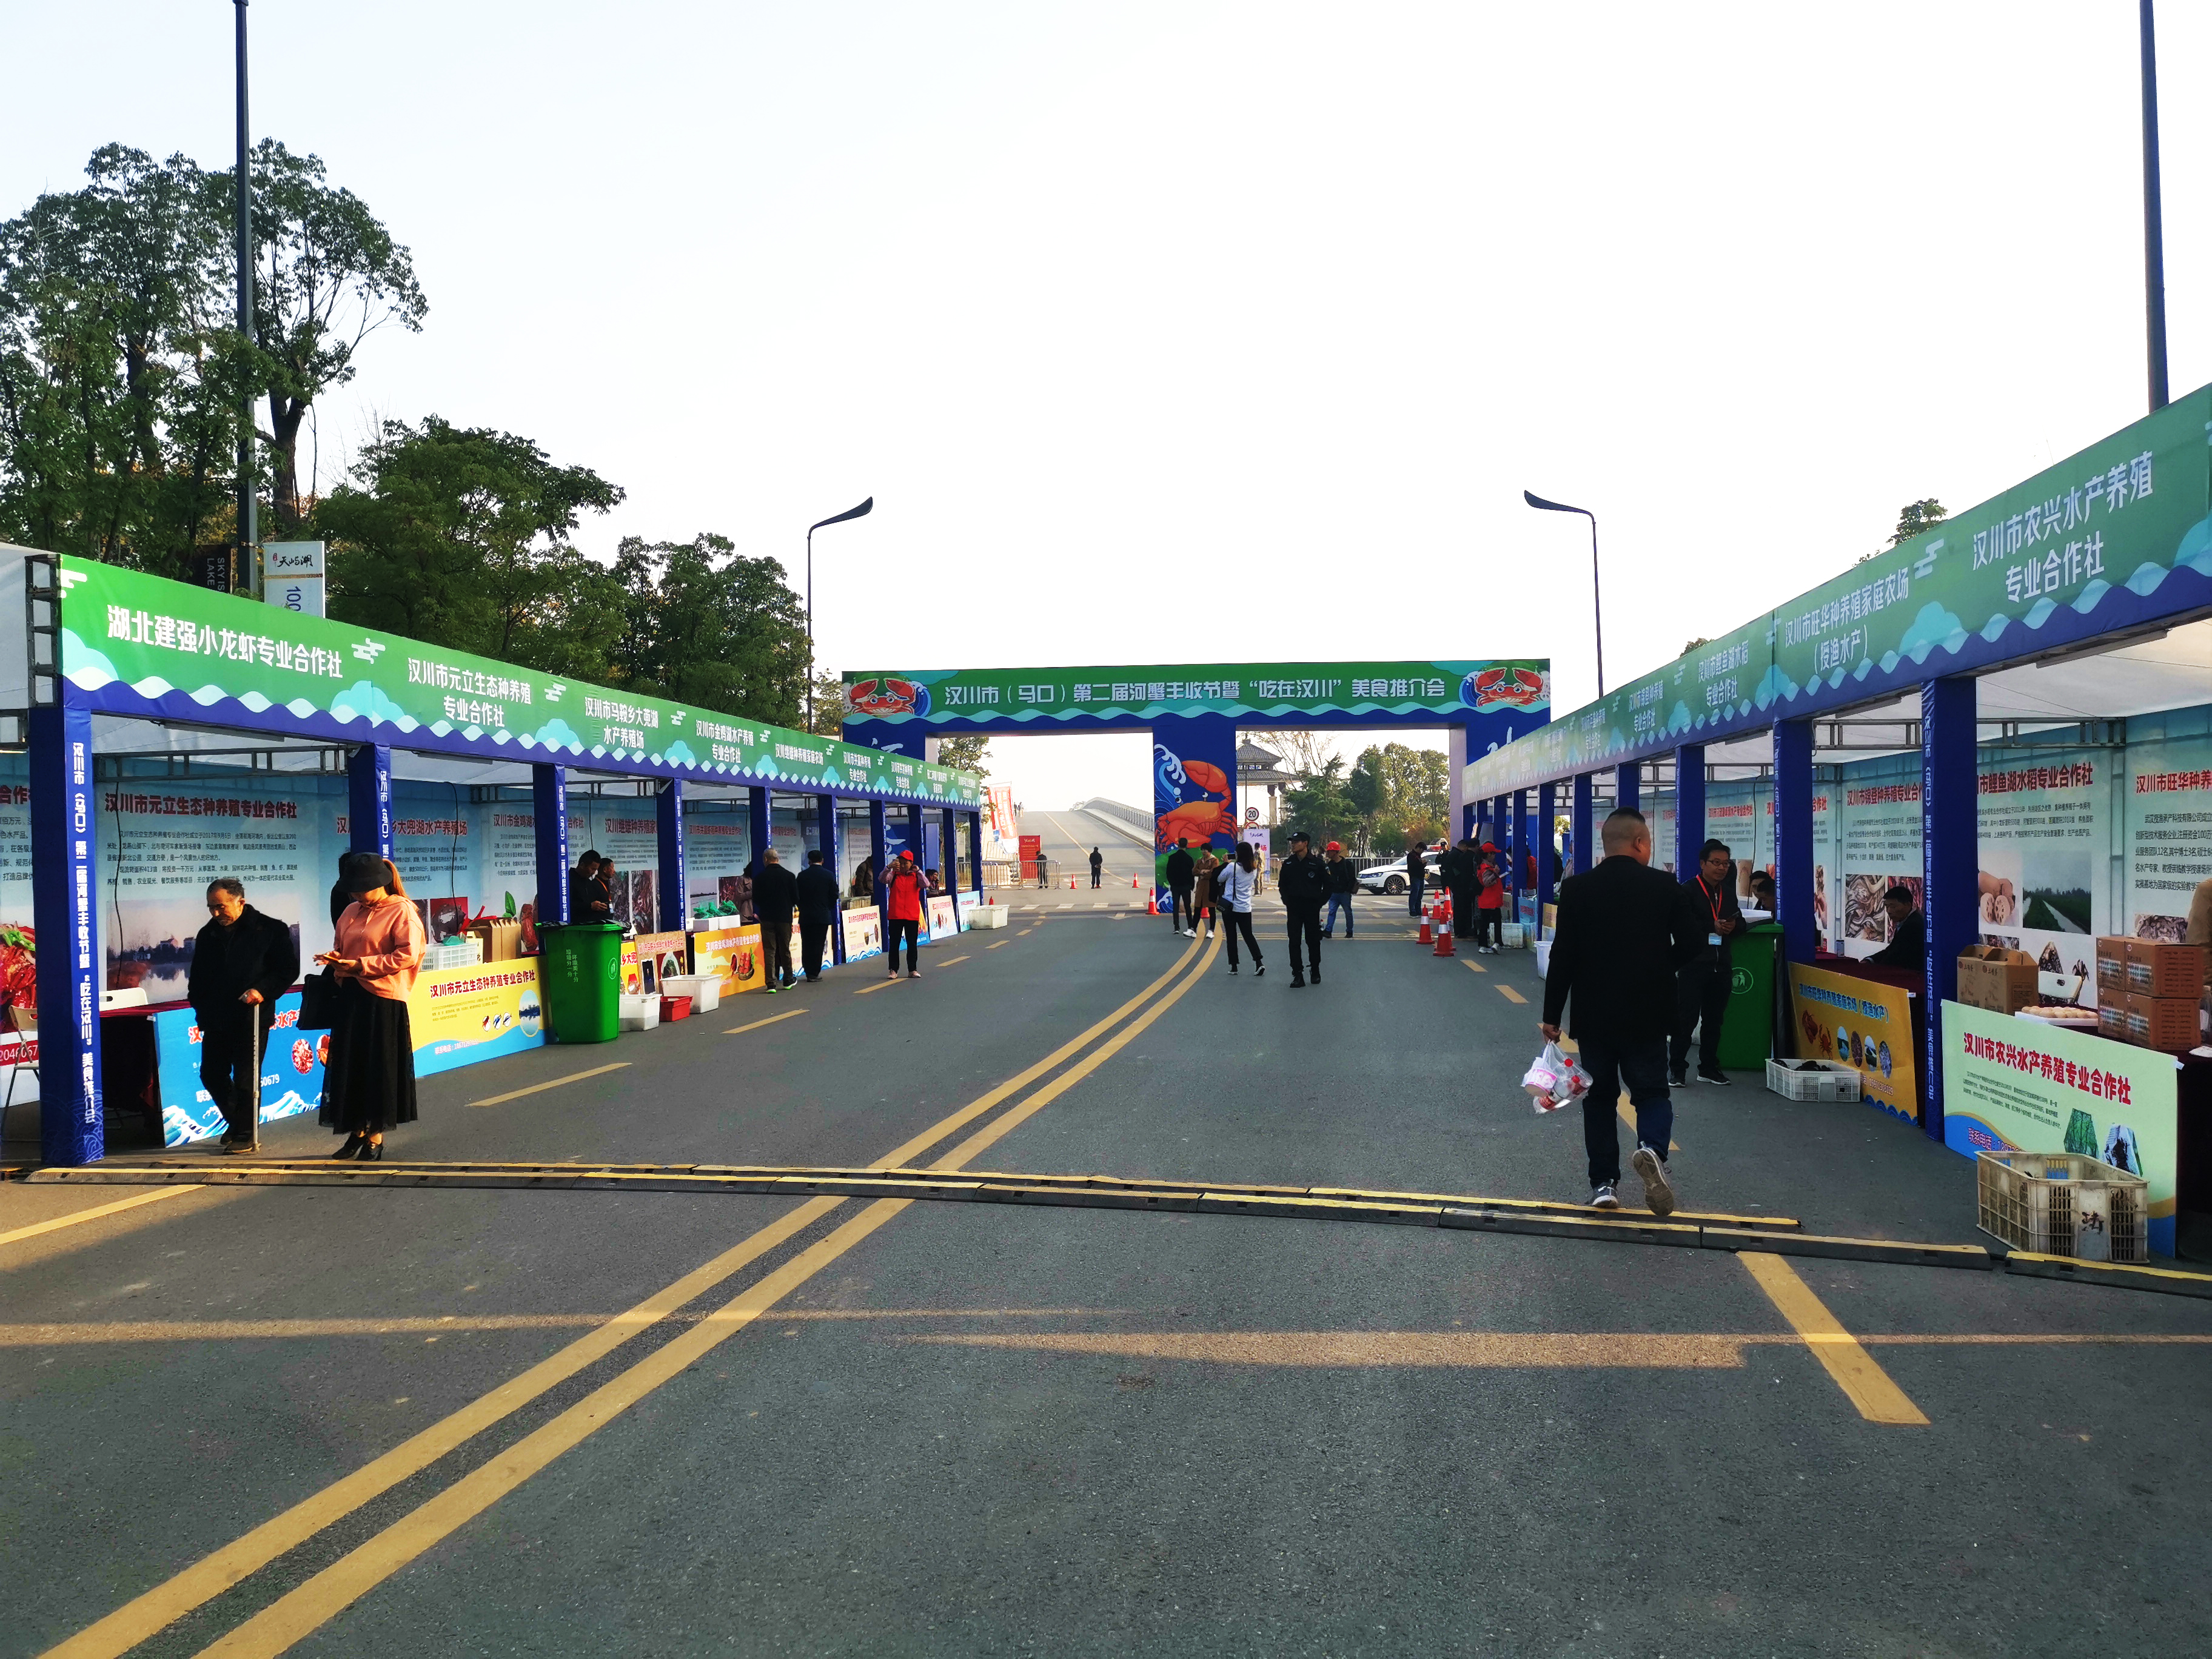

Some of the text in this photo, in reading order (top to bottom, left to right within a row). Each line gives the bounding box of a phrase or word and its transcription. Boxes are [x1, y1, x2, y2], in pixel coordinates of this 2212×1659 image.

[1972, 450, 2153, 571] 汉川市农兴水产养殖
[207, 558, 215, 586] LAKE
[2005, 531, 2105, 603] 专业合作社
[1785, 567, 1909, 648] 汉川市旺华种养殖家庭农场
[107, 604, 343, 679] 湖北建强小龙虾专业合作社
[407, 657, 531, 705] 汉川市元立生态种养殖
[1706, 675, 1738, 708] 专业合作社
[443, 695, 504, 728] 专业合作社
[603, 725, 644, 749] 水产养殖场
[696, 719, 754, 746] 汉川市金鸡湖水产养殖
[712, 743, 741, 764] 专业合作社
[849, 768, 867, 783] 专业合作社
[1977, 762, 2093, 795] 市鲤鱼湖水稻专业合作社
[0, 785, 30, 805] 合作
[104, 793, 297, 819] 汉川市元立生态种养殖专业合作社
[605, 817, 658, 834] 汉川继雄种养殖家
[430, 970, 535, 998] 汉川市元立生态种养殖专业合作社
[1963, 1032, 2131, 1105] 汉川市农兴水产养殖专业合作社
